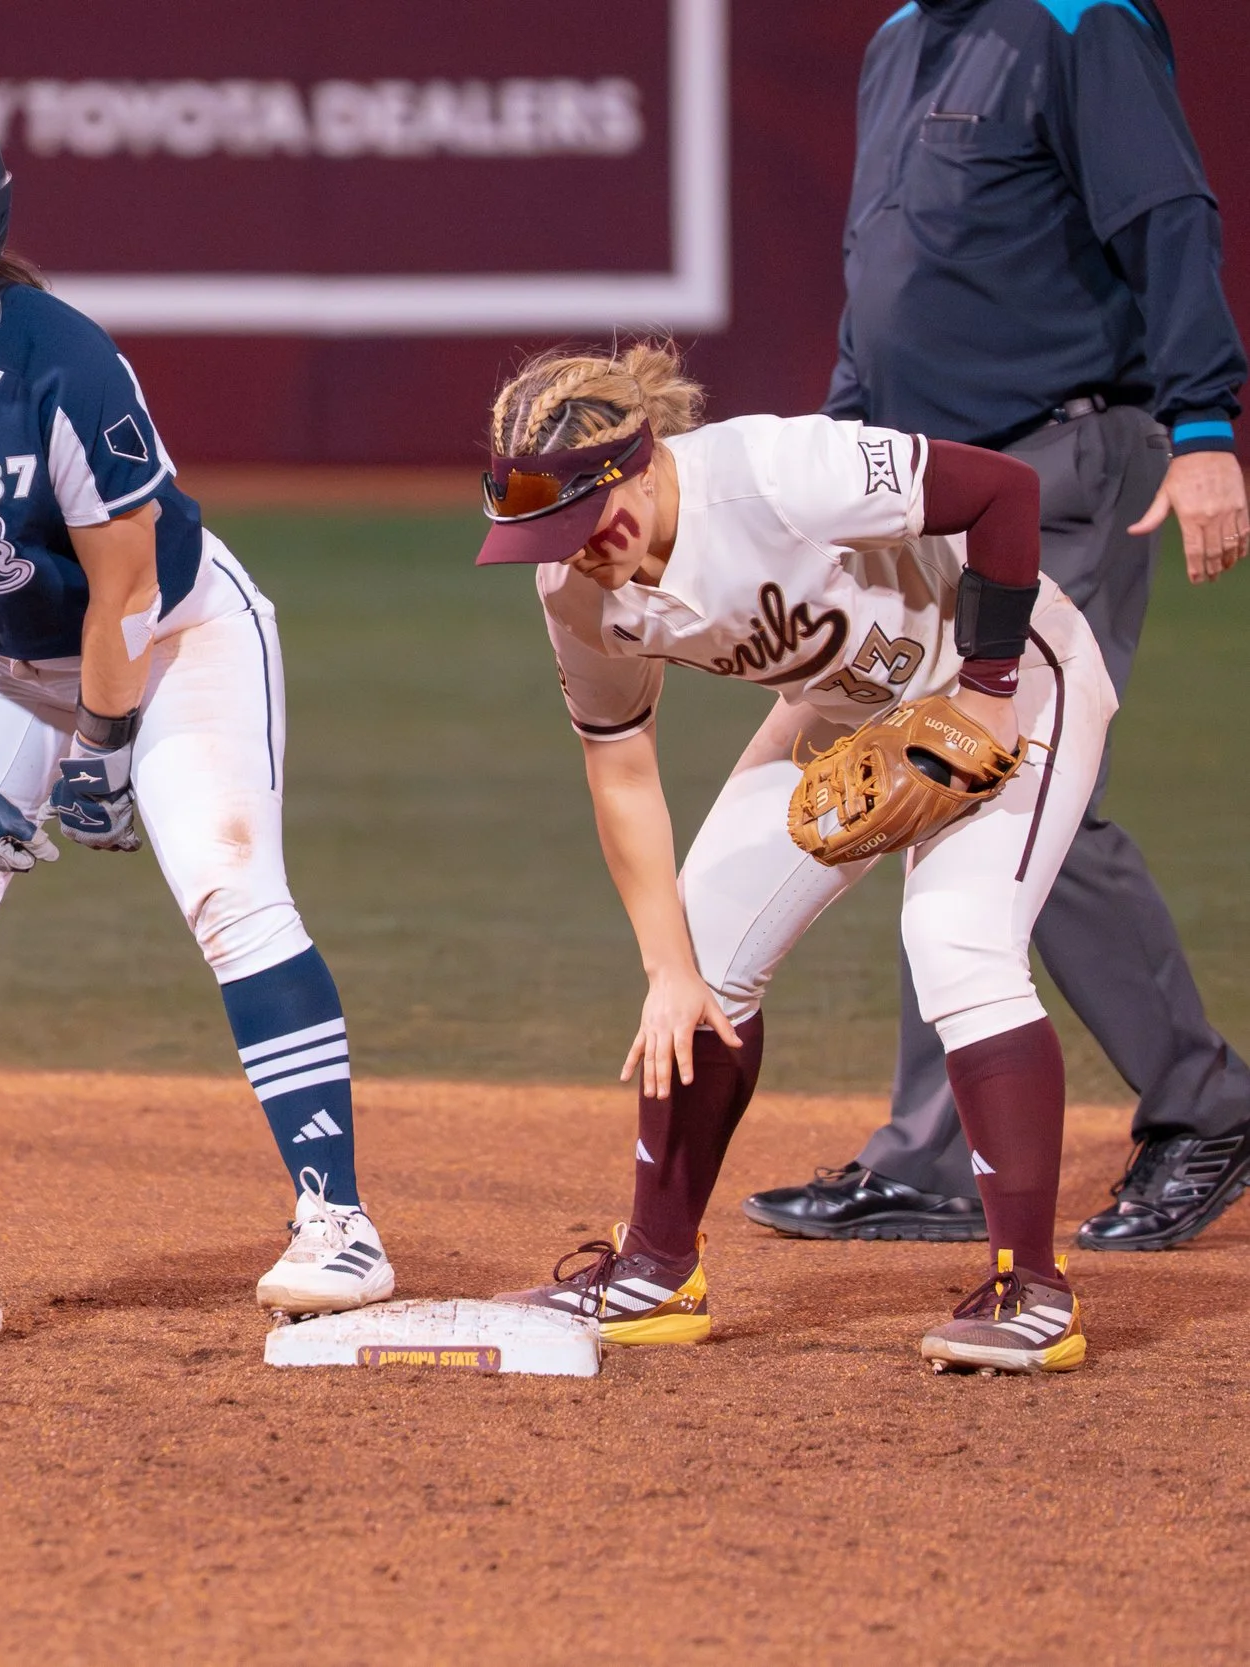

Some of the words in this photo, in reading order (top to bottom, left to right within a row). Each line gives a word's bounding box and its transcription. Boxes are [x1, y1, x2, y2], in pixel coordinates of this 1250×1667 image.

[24, 80, 307, 156] TOYOTA
[311, 79, 644, 157] DEALERS
[708, 581, 850, 685] evils
[925, 716, 979, 756] Wilson
[378, 1351, 436, 1367] ARIZONA
[440, 1351, 479, 1367] STATE
